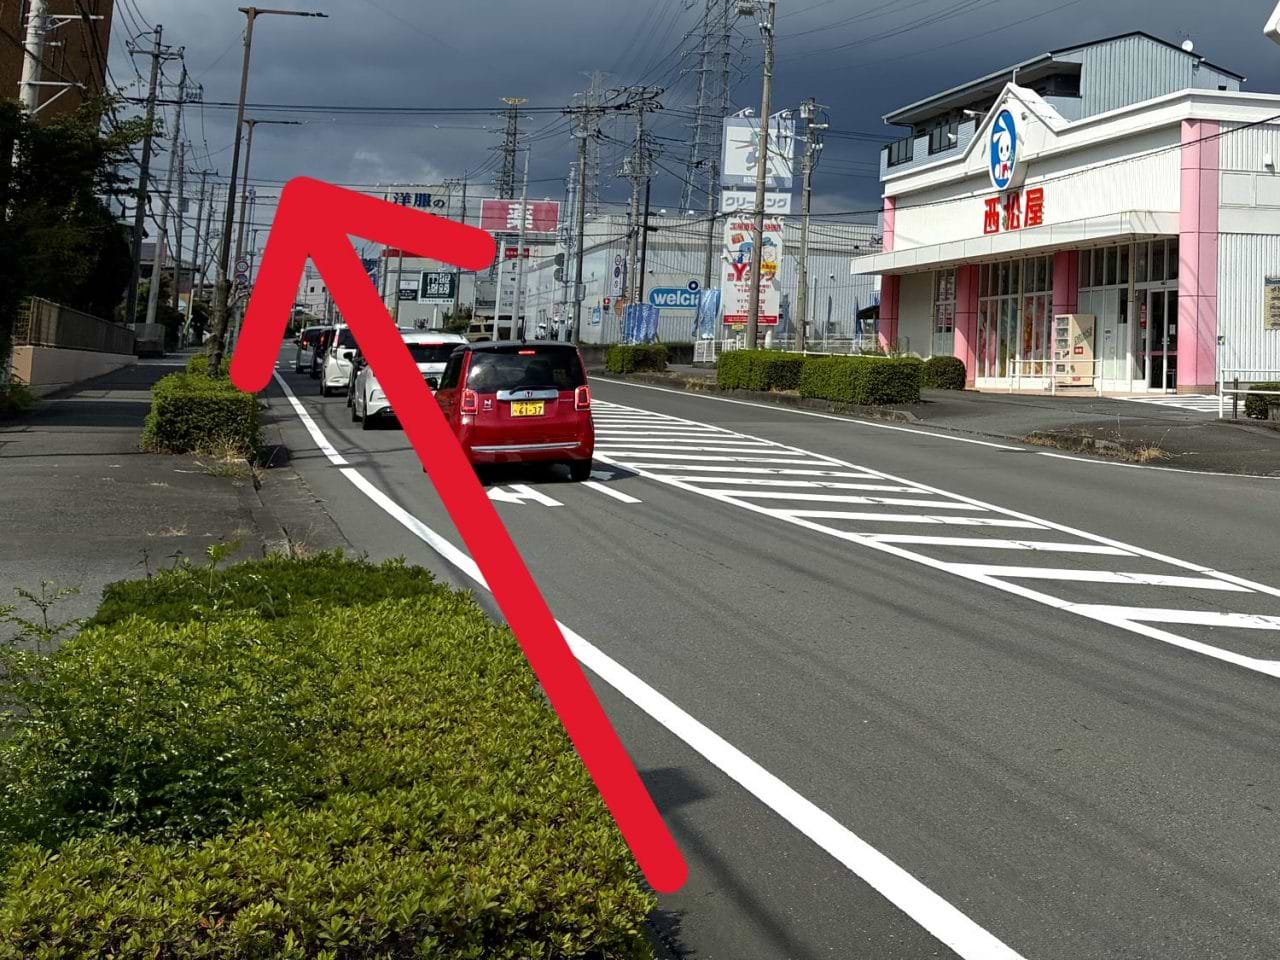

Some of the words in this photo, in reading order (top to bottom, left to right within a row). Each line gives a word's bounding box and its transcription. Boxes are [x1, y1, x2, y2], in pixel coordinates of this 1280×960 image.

[393, 192, 446, 208] 洋服の
[725, 196, 787, 208] クリーング
[507, 203, 534, 229] 薬
[983, 187, 1044, 235] 西松屋
